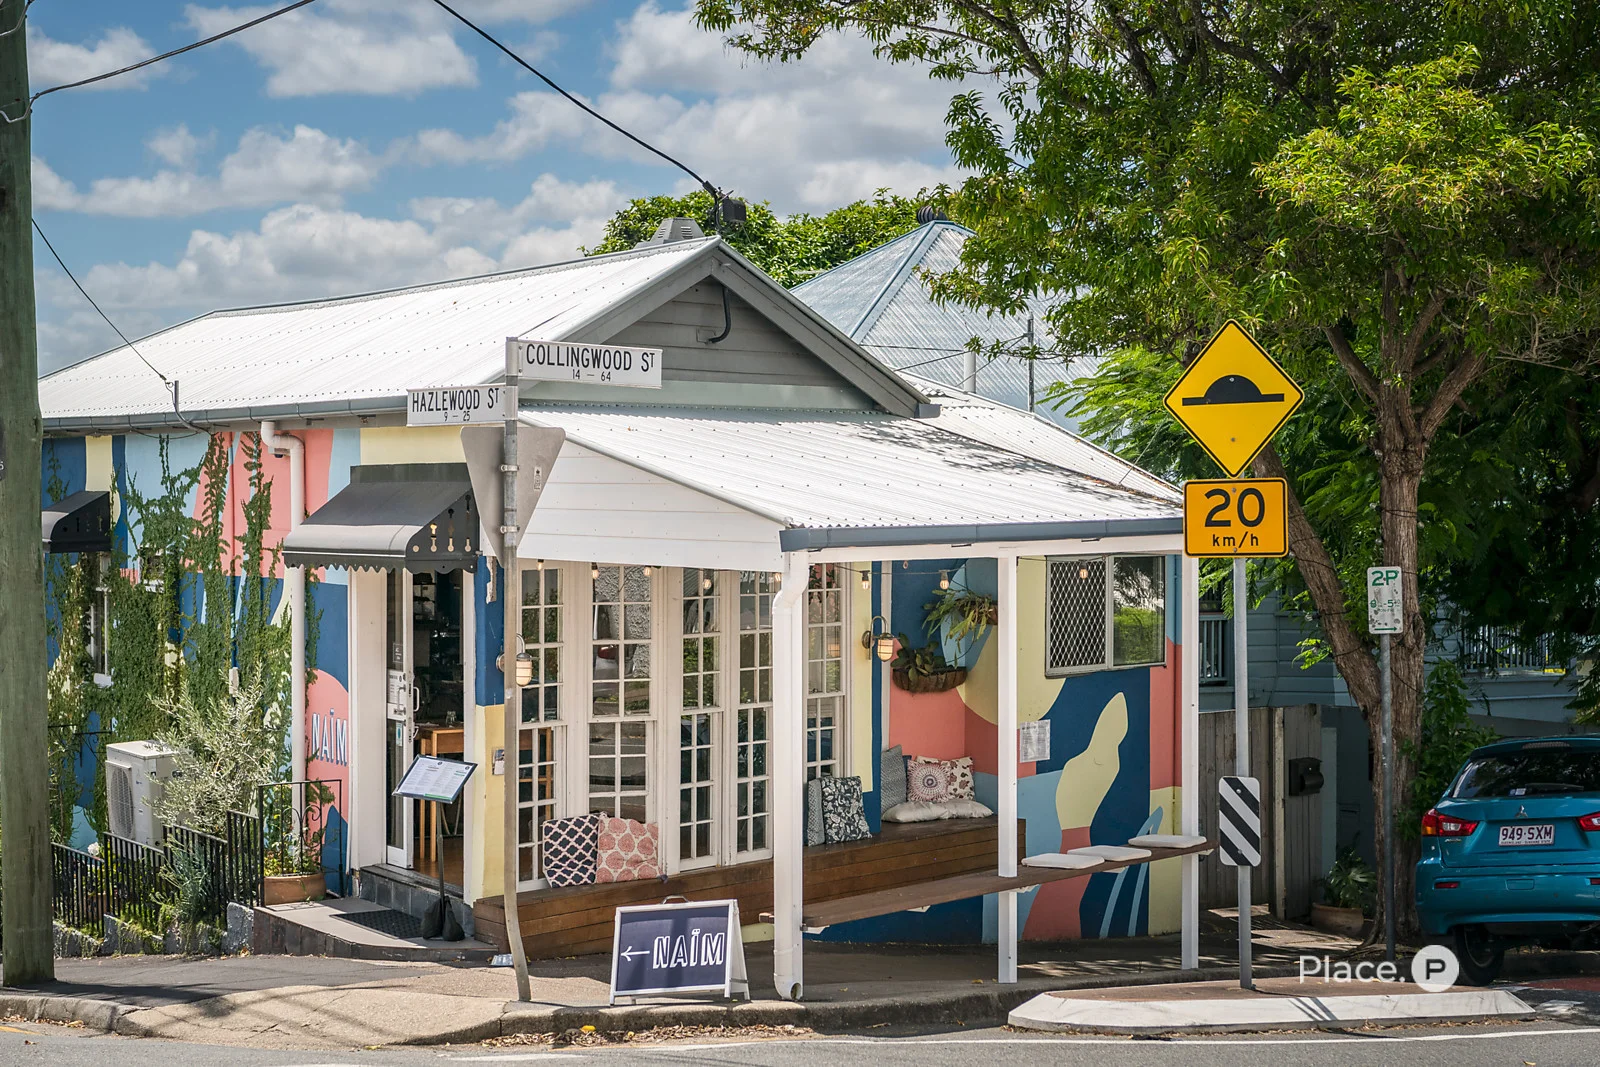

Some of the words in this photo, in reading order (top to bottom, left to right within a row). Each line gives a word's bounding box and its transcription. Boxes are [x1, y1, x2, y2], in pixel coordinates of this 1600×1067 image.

[526, 343, 632, 371] COLLINGWOOD
[641, 352, 655, 372] ST
[572, 369, 581, 380] 14
[600, 370, 611, 382] 64
[412, 389, 480, 413] HAZLEWOOD
[487, 388, 499, 409] ST
[443, 411, 449, 422] 9
[463, 411, 471, 422] 25
[1204, 487, 1266, 528] 20
[1212, 531, 1259, 548] km/h
[1371, 570, 1398, 586] 2P
